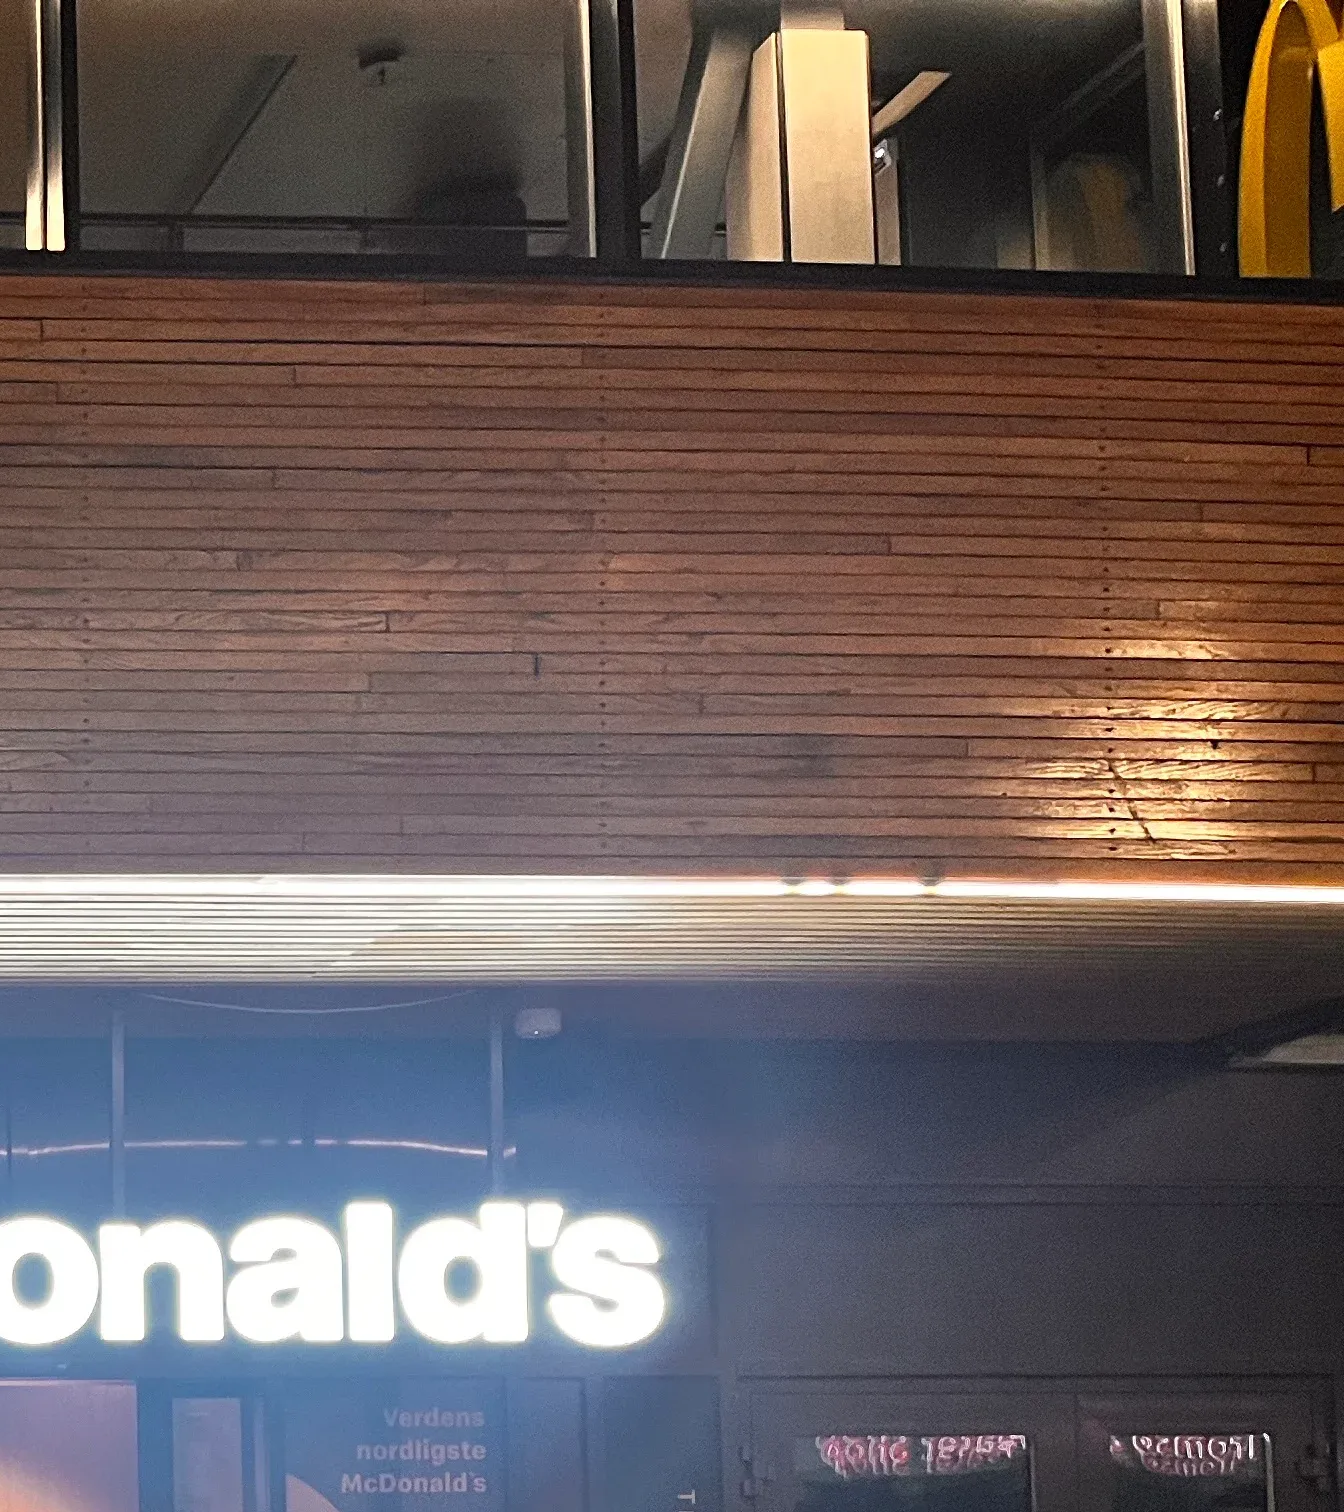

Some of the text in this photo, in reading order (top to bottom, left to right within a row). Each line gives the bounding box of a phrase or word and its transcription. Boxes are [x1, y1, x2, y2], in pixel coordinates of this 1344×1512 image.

[383, 1407, 485, 1428] Verdens
[356, 1438, 487, 1466] nordligste
[341, 1471, 487, 1494] McDonald's
